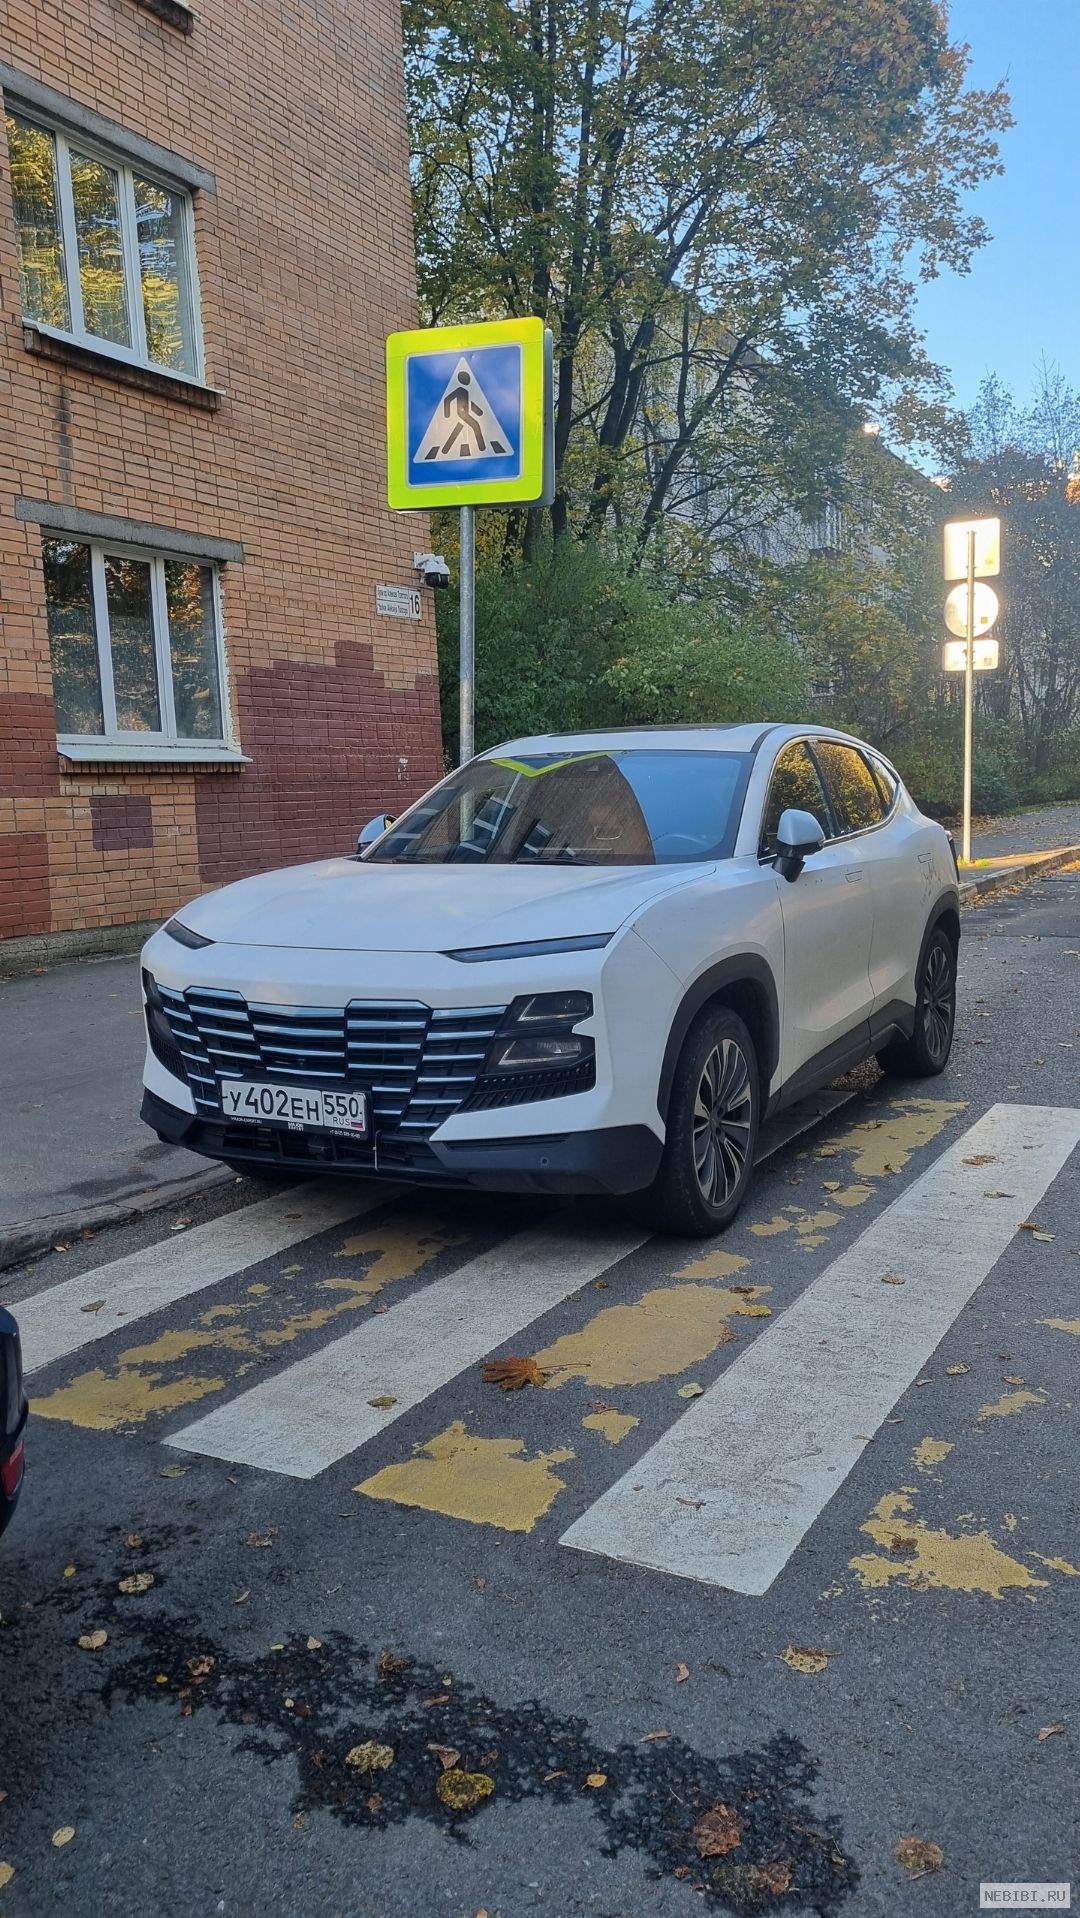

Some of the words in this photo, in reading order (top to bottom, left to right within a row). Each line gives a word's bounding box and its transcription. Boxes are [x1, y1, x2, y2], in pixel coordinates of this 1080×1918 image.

[410, 594, 420, 615] 16
[323, 1094, 359, 1118] 550
[333, 1117, 350, 1126] RUS
